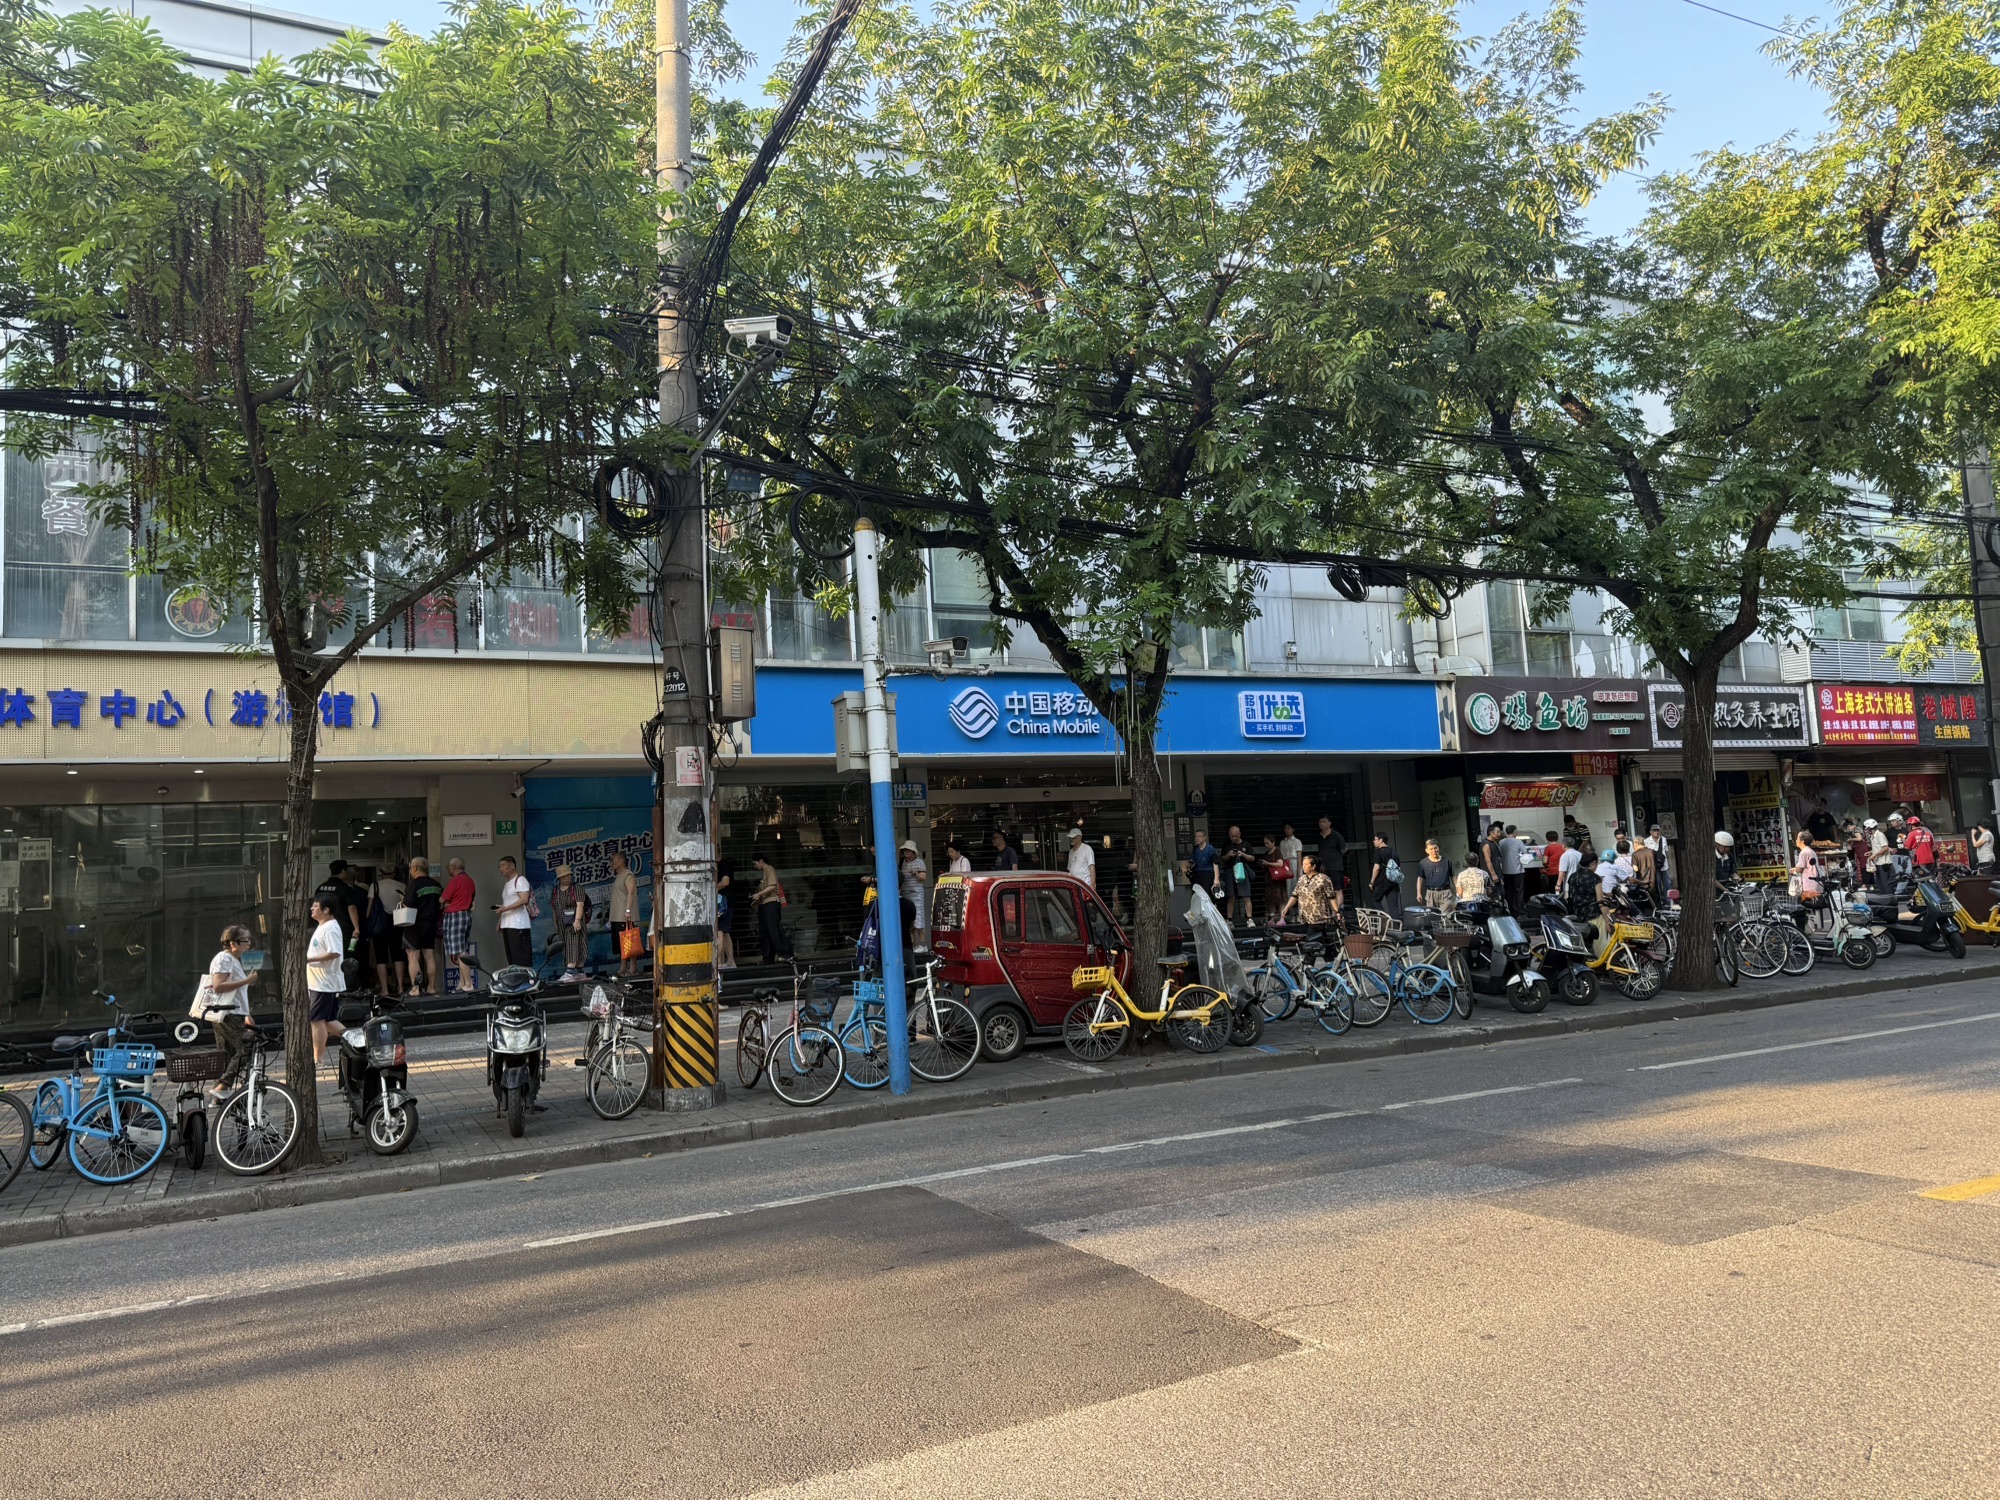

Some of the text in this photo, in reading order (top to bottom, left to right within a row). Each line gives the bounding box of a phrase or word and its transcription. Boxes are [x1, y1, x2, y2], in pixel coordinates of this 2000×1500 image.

[42, 455, 89, 536] 西餐
[1005, 691, 1099, 716] 中国移动
[1244, 694, 1256, 719] 移动
[1258, 694, 1301, 719] 优选
[1502, 690, 1588, 731] 爆鱼坊
[1679, 701, 1800, 729] 热灸养生馆
[1835, 690, 1914, 715] 上海老式大饼油条
[1921, 694, 1978, 720] 老城隍
[1007, 719, 1100, 734] China Mobile
[1935, 725, 1971, 739] 生煎锅贴
[502, 821, 512, 830] 50
[549, 830, 597, 845] SWIMMING
[547, 831, 652, 870] 普陀体育中心
[575, 854, 641, 884] 游泳）
